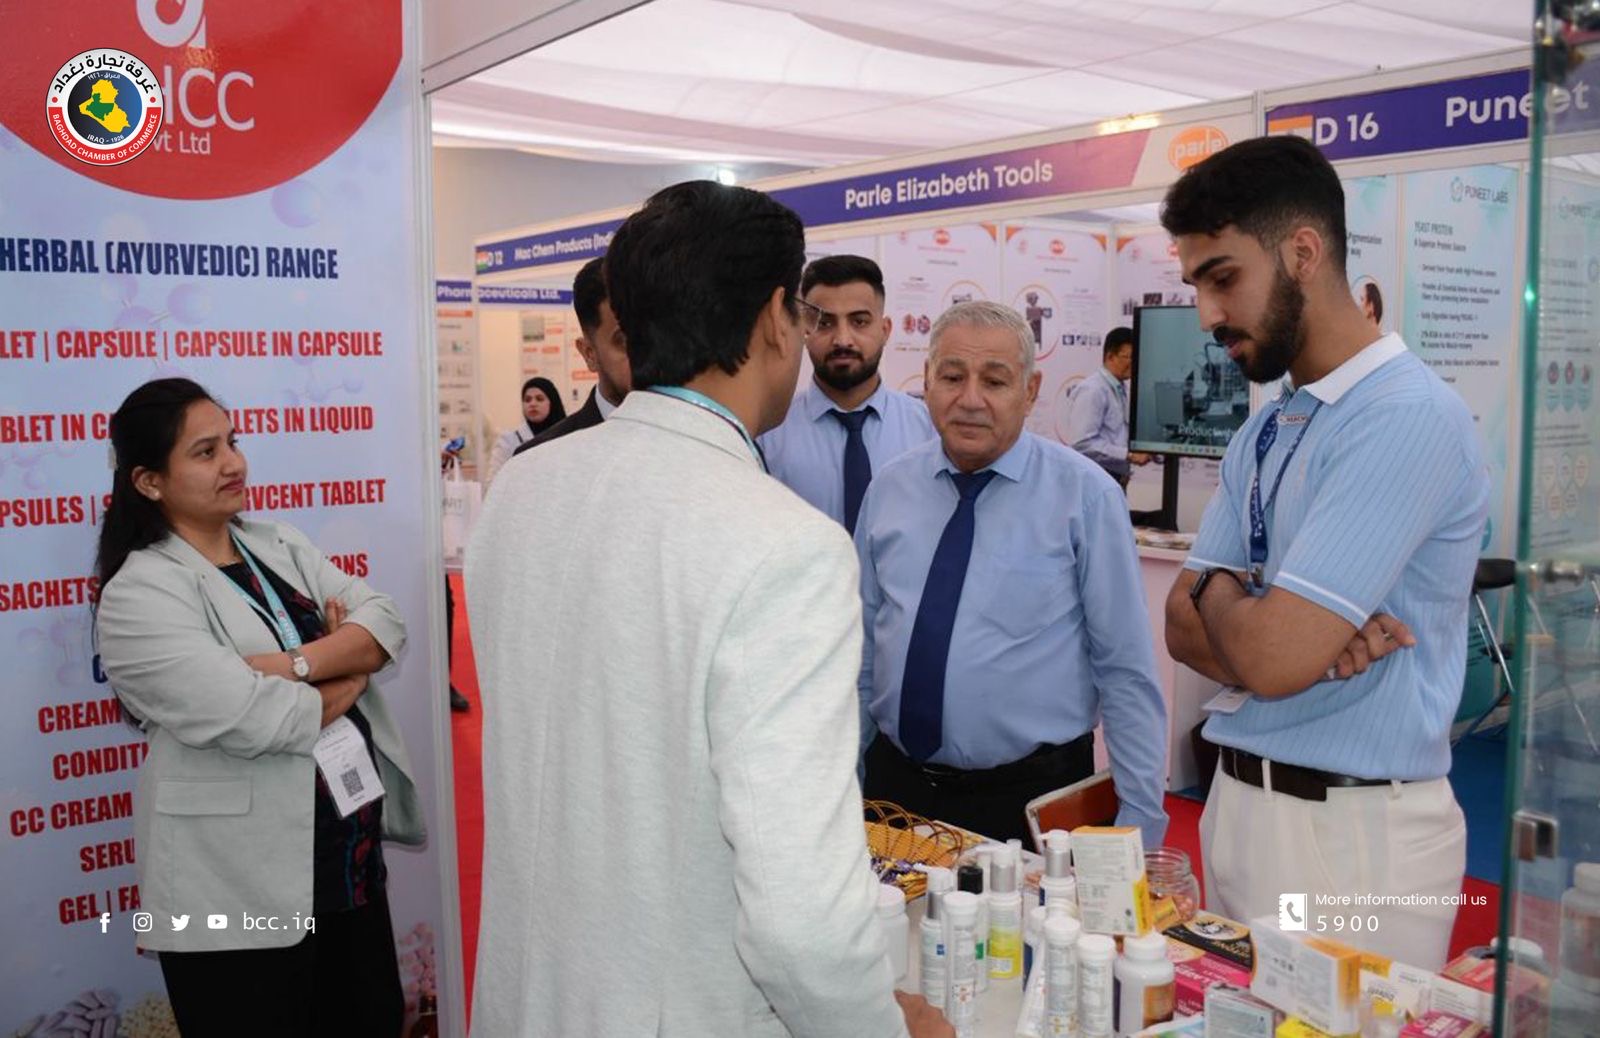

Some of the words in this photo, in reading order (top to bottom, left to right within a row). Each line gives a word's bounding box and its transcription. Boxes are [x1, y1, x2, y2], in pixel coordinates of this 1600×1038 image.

[179, 130, 210, 154] Ltd
[1315, 117, 1338, 146] D
[1347, 112, 1379, 141] 16
[845, 184, 892, 210] Parle
[897, 167, 989, 202] Elizabeth
[994, 159, 1053, 188] Tools
[0, 237, 99, 273] HERBAL
[105, 241, 260, 278] (AYURVEDIC)
[266, 246, 339, 279] RANGE
[556, 238, 592, 254] Products
[56, 331, 157, 359] CAPSULE
[175, 331, 267, 357] CAPSULE
[272, 331, 293, 356] IN
[298, 331, 383, 357] CAPSULE
[62, 413, 85, 441] IN
[284, 408, 305, 432] IN
[310, 406, 373, 433] LIQUID
[319, 479, 386, 506] TABLET
[0, 575, 101, 612] SACHETS
[10, 806, 45, 837] CC
[51, 791, 133, 829] CREAM
[59, 893, 100, 925] GEL
